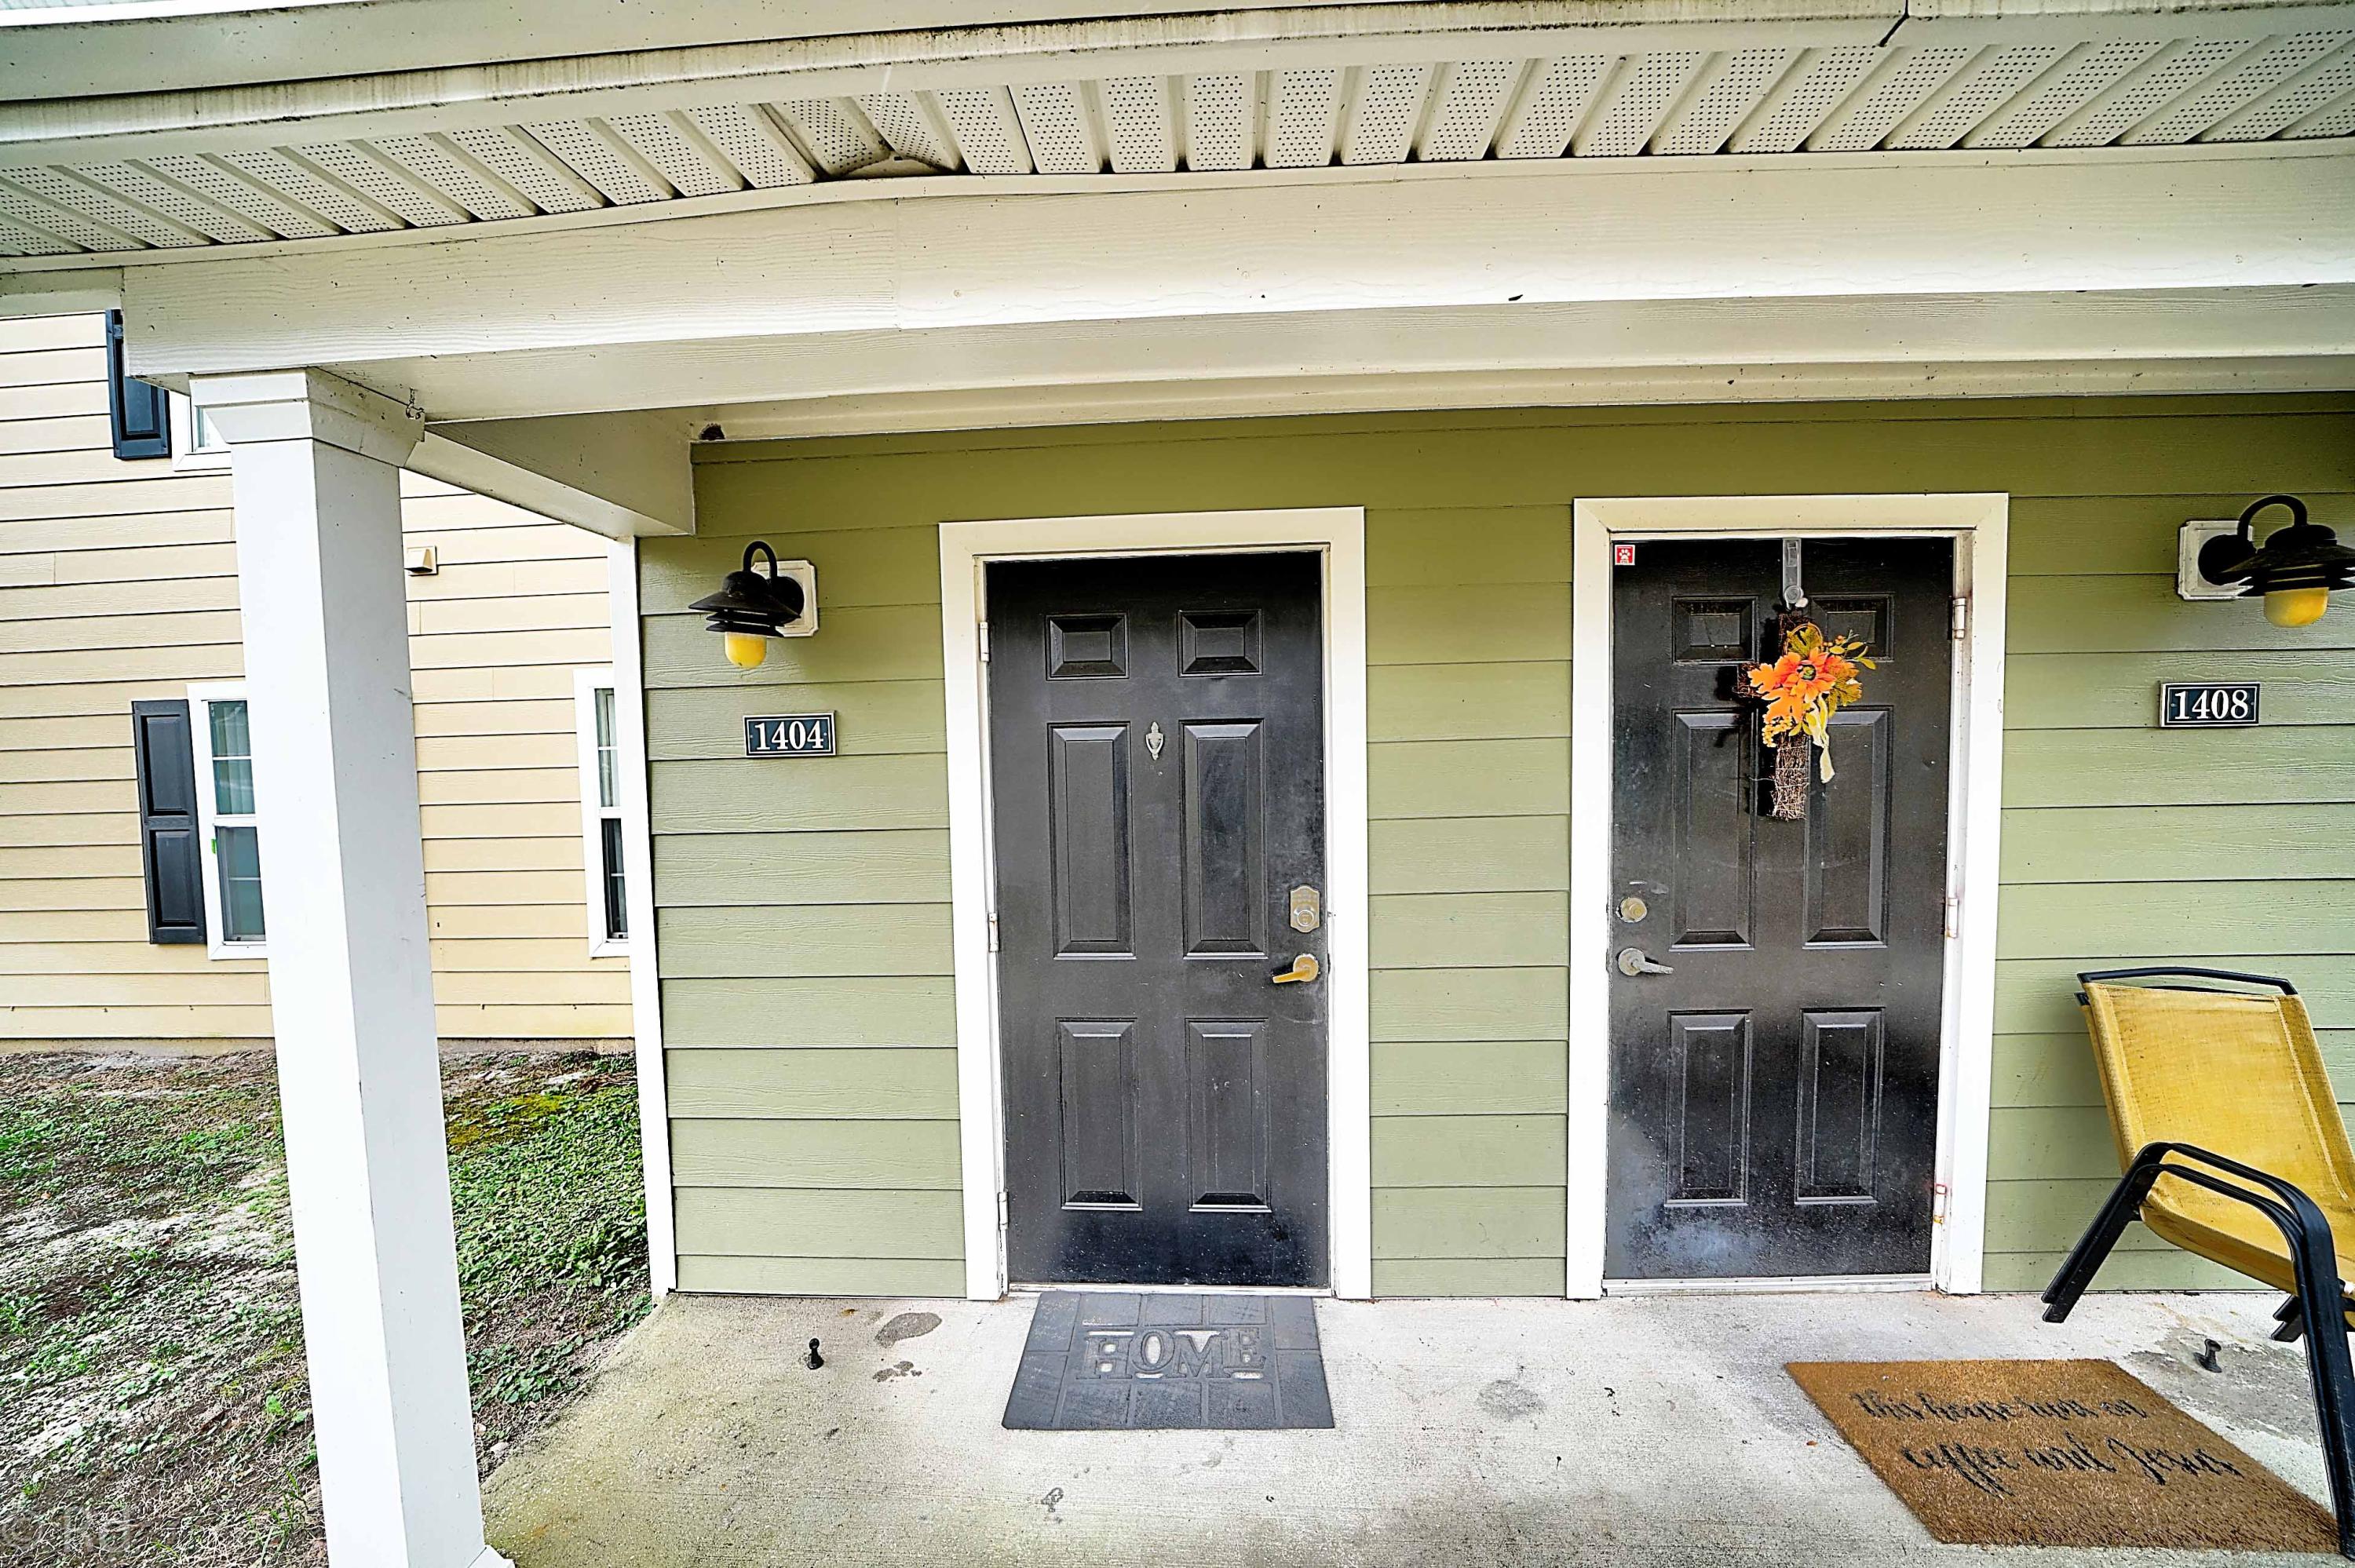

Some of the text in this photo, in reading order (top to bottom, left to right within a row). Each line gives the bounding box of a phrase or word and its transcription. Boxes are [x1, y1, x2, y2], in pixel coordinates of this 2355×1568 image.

[2174, 689, 2248, 720] 1408
[754, 720, 823, 750] 1404
[1077, 1329, 1265, 1380] HOME
[2100, 1398, 2148, 1419] on
[1900, 1430, 2244, 1497] coffee and Jesus
